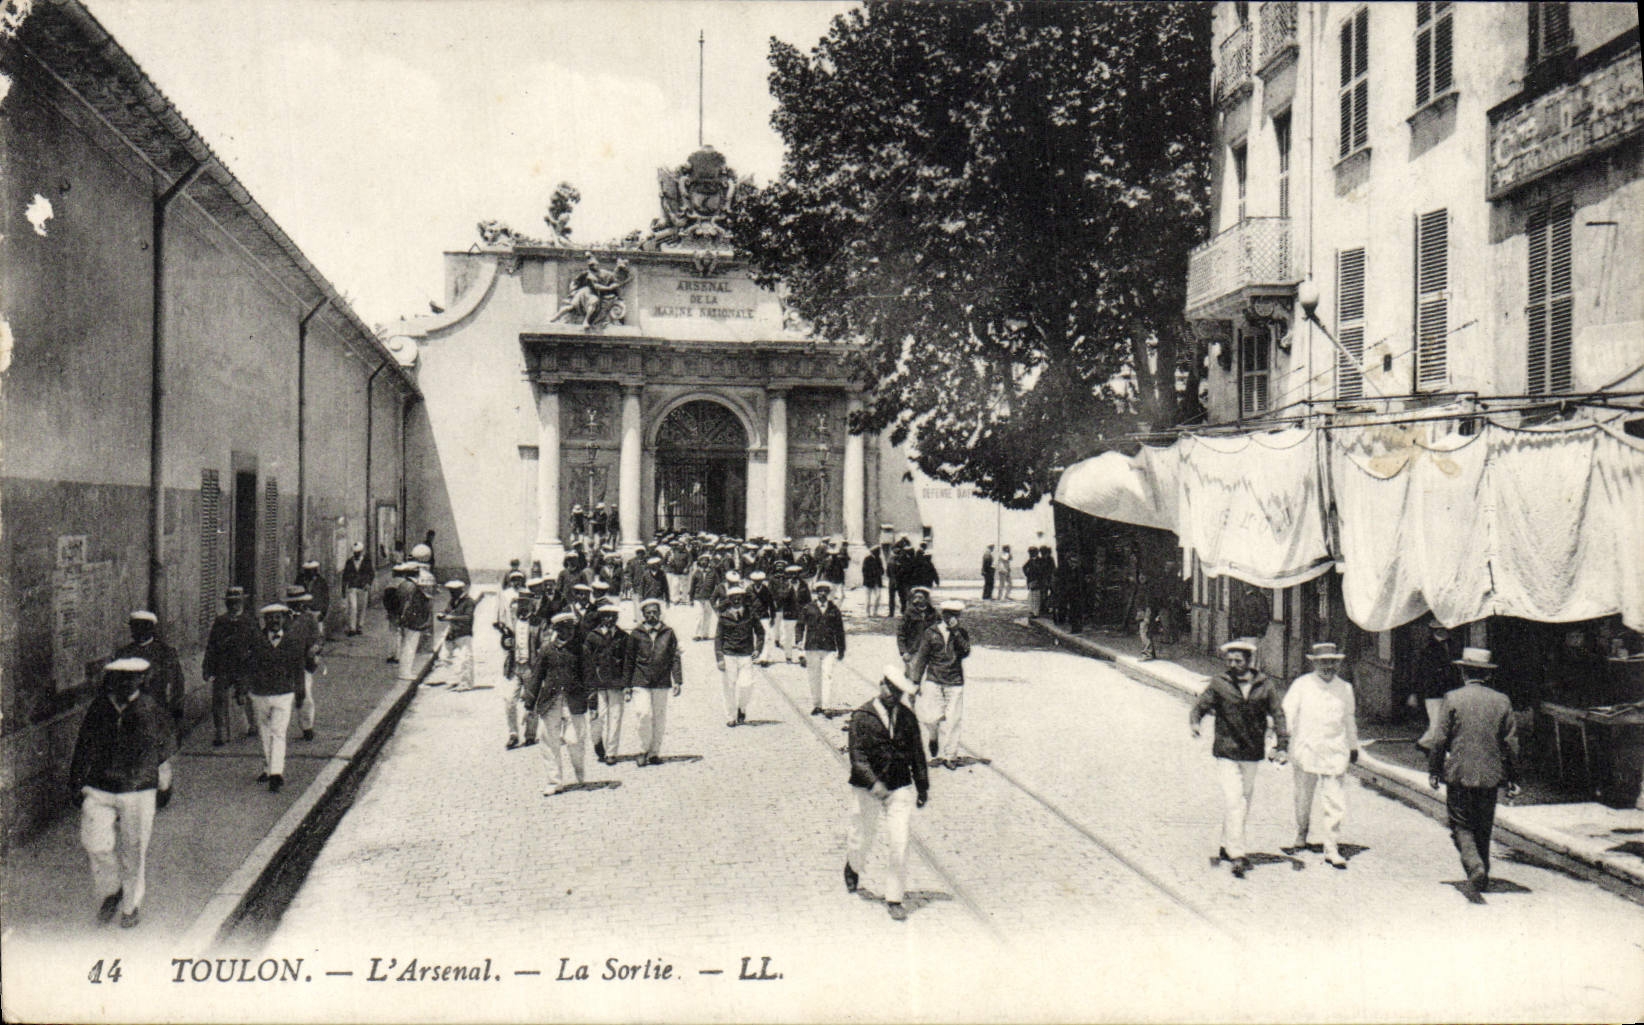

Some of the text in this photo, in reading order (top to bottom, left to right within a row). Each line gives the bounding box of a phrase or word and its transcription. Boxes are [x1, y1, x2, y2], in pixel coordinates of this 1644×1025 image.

[676, 280, 732, 293] ARSENAL
[690, 294, 718, 304] DE LA
